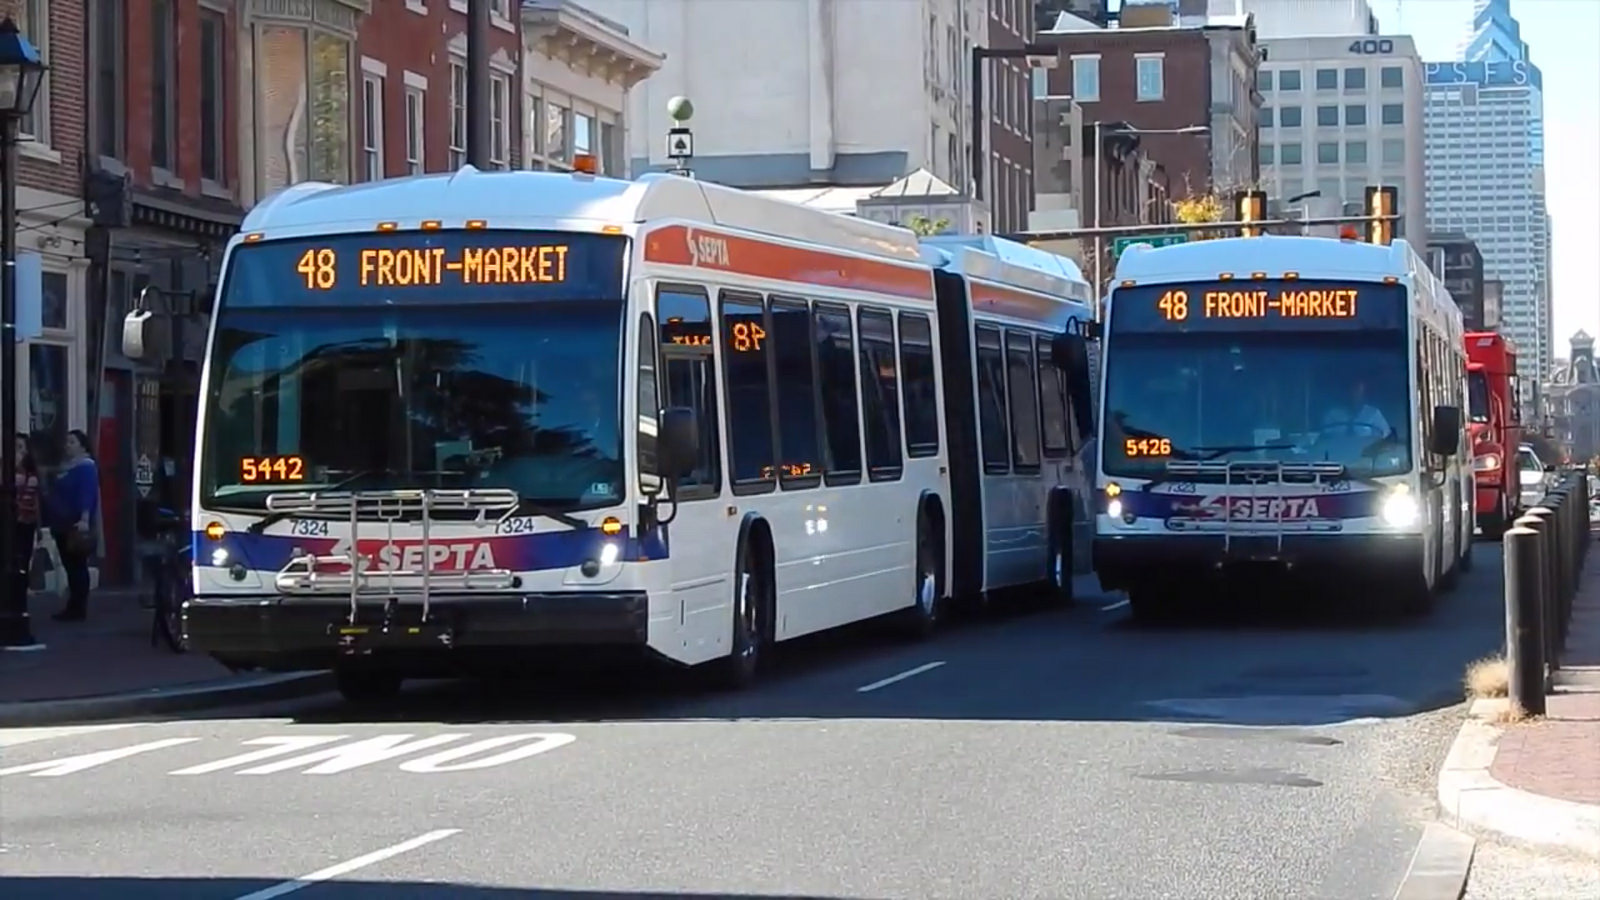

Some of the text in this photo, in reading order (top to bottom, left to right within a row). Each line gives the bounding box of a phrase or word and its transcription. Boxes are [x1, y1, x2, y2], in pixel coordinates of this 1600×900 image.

[1349, 40, 1393, 54] 400
[699, 234, 730, 266] SEPTA
[298, 246, 568, 289] 48 FRONT-MARKET
[1159, 291, 1358, 320] 48 FRONT-MARKET
[1126, 438, 1171, 456] 5426
[242, 457, 303, 480] 5442
[1233, 499, 1319, 519] SEPTA
[290, 519, 329, 536] 7324
[378, 542, 496, 571] SEPTA
